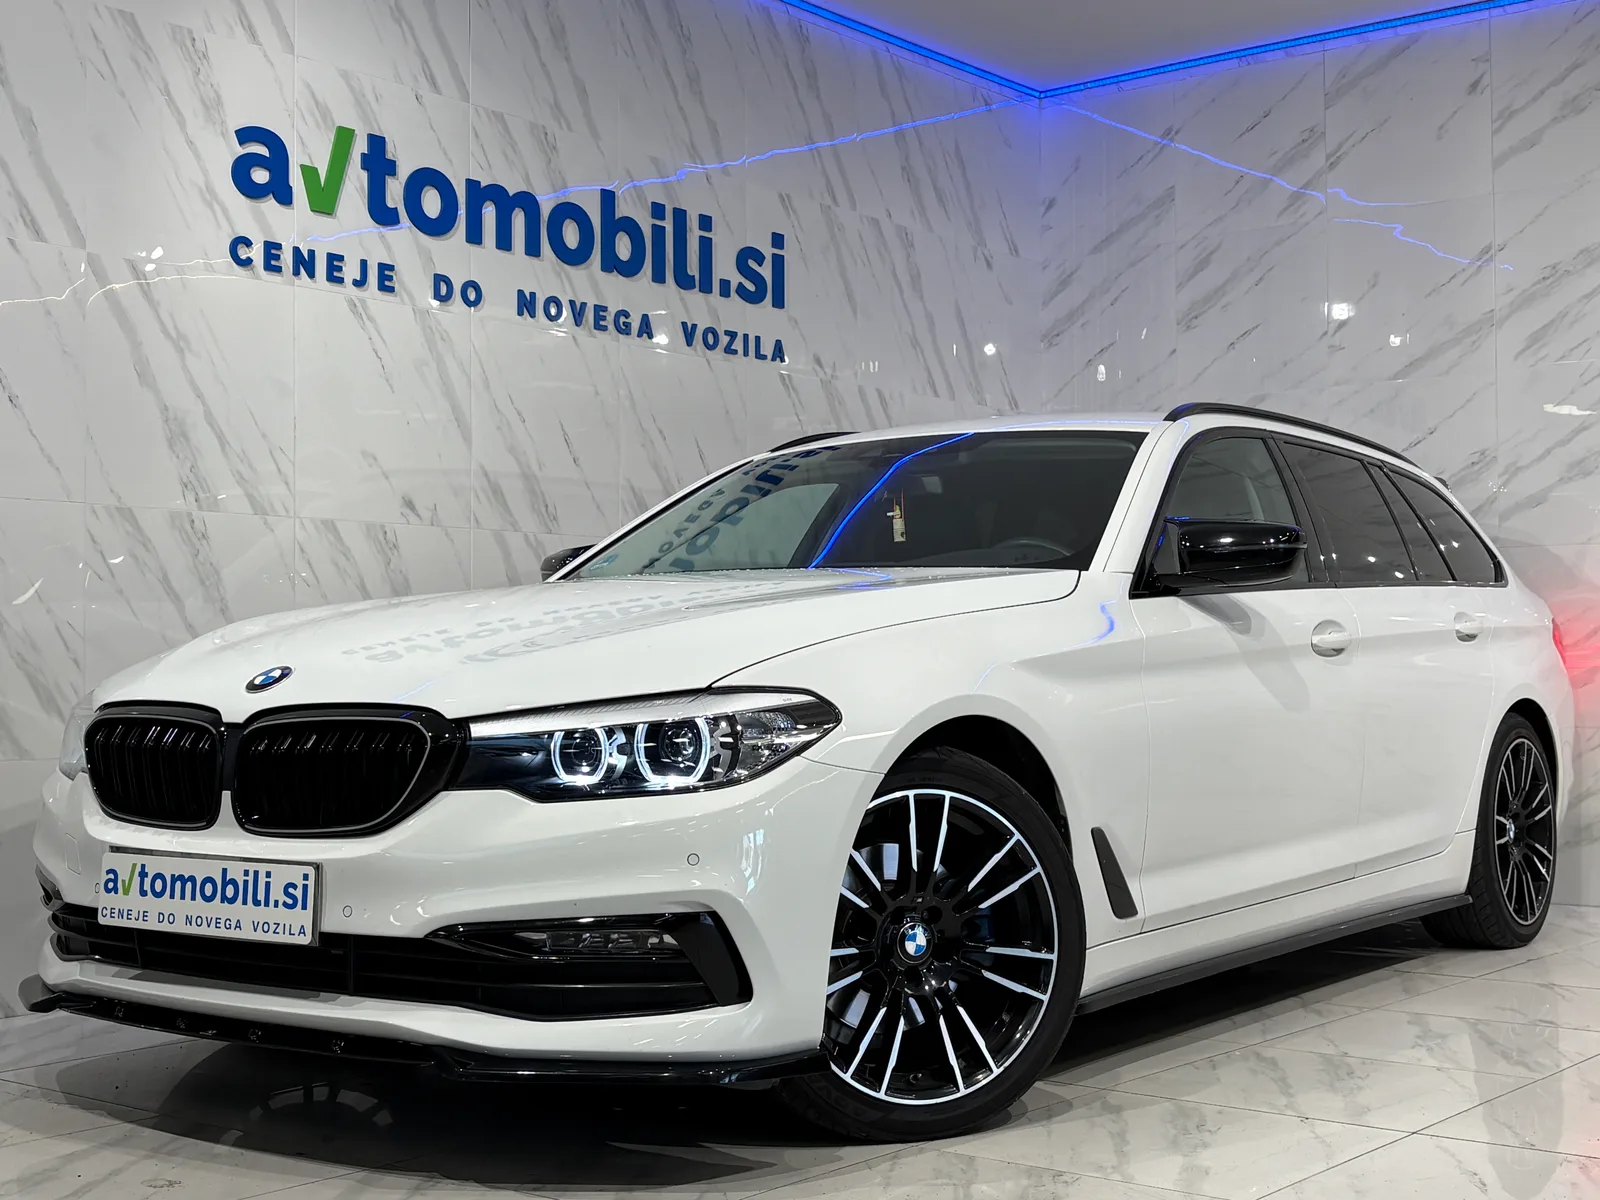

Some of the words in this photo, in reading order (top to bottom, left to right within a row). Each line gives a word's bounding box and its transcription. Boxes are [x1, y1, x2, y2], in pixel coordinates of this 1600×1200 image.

[228, 235, 397, 294] CENEJE
[433, 272, 484, 309] DO
[516, 288, 655, 341] NOVEGA
[681, 320, 788, 364] VOZILA
[100, 906, 149, 922] CENEJE
[157, 911, 176, 925] DO
[184, 914, 243, 931] NOVEGA
[252, 920, 307, 937] VOZILA
